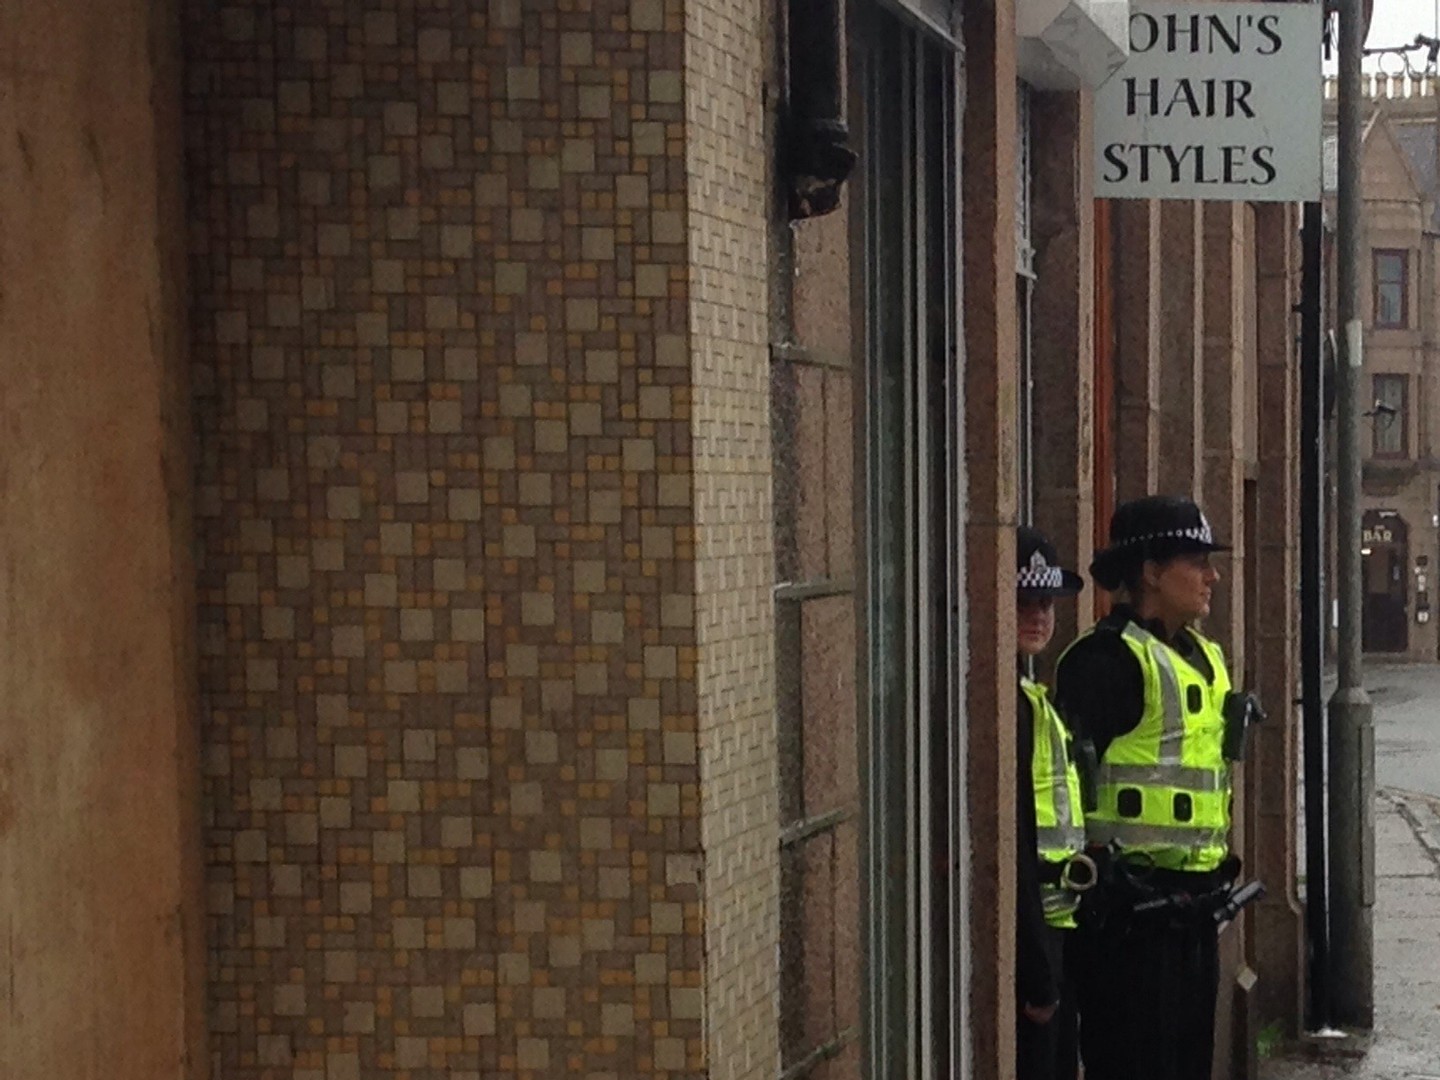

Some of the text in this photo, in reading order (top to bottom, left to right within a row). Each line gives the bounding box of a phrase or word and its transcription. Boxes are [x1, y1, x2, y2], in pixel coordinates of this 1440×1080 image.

[1129, 13, 1282, 55] OHN'S
[1122, 77, 1255, 118] HAIR
[1103, 143, 1277, 185] STYLES
[1362, 529, 1393, 543] BAR
